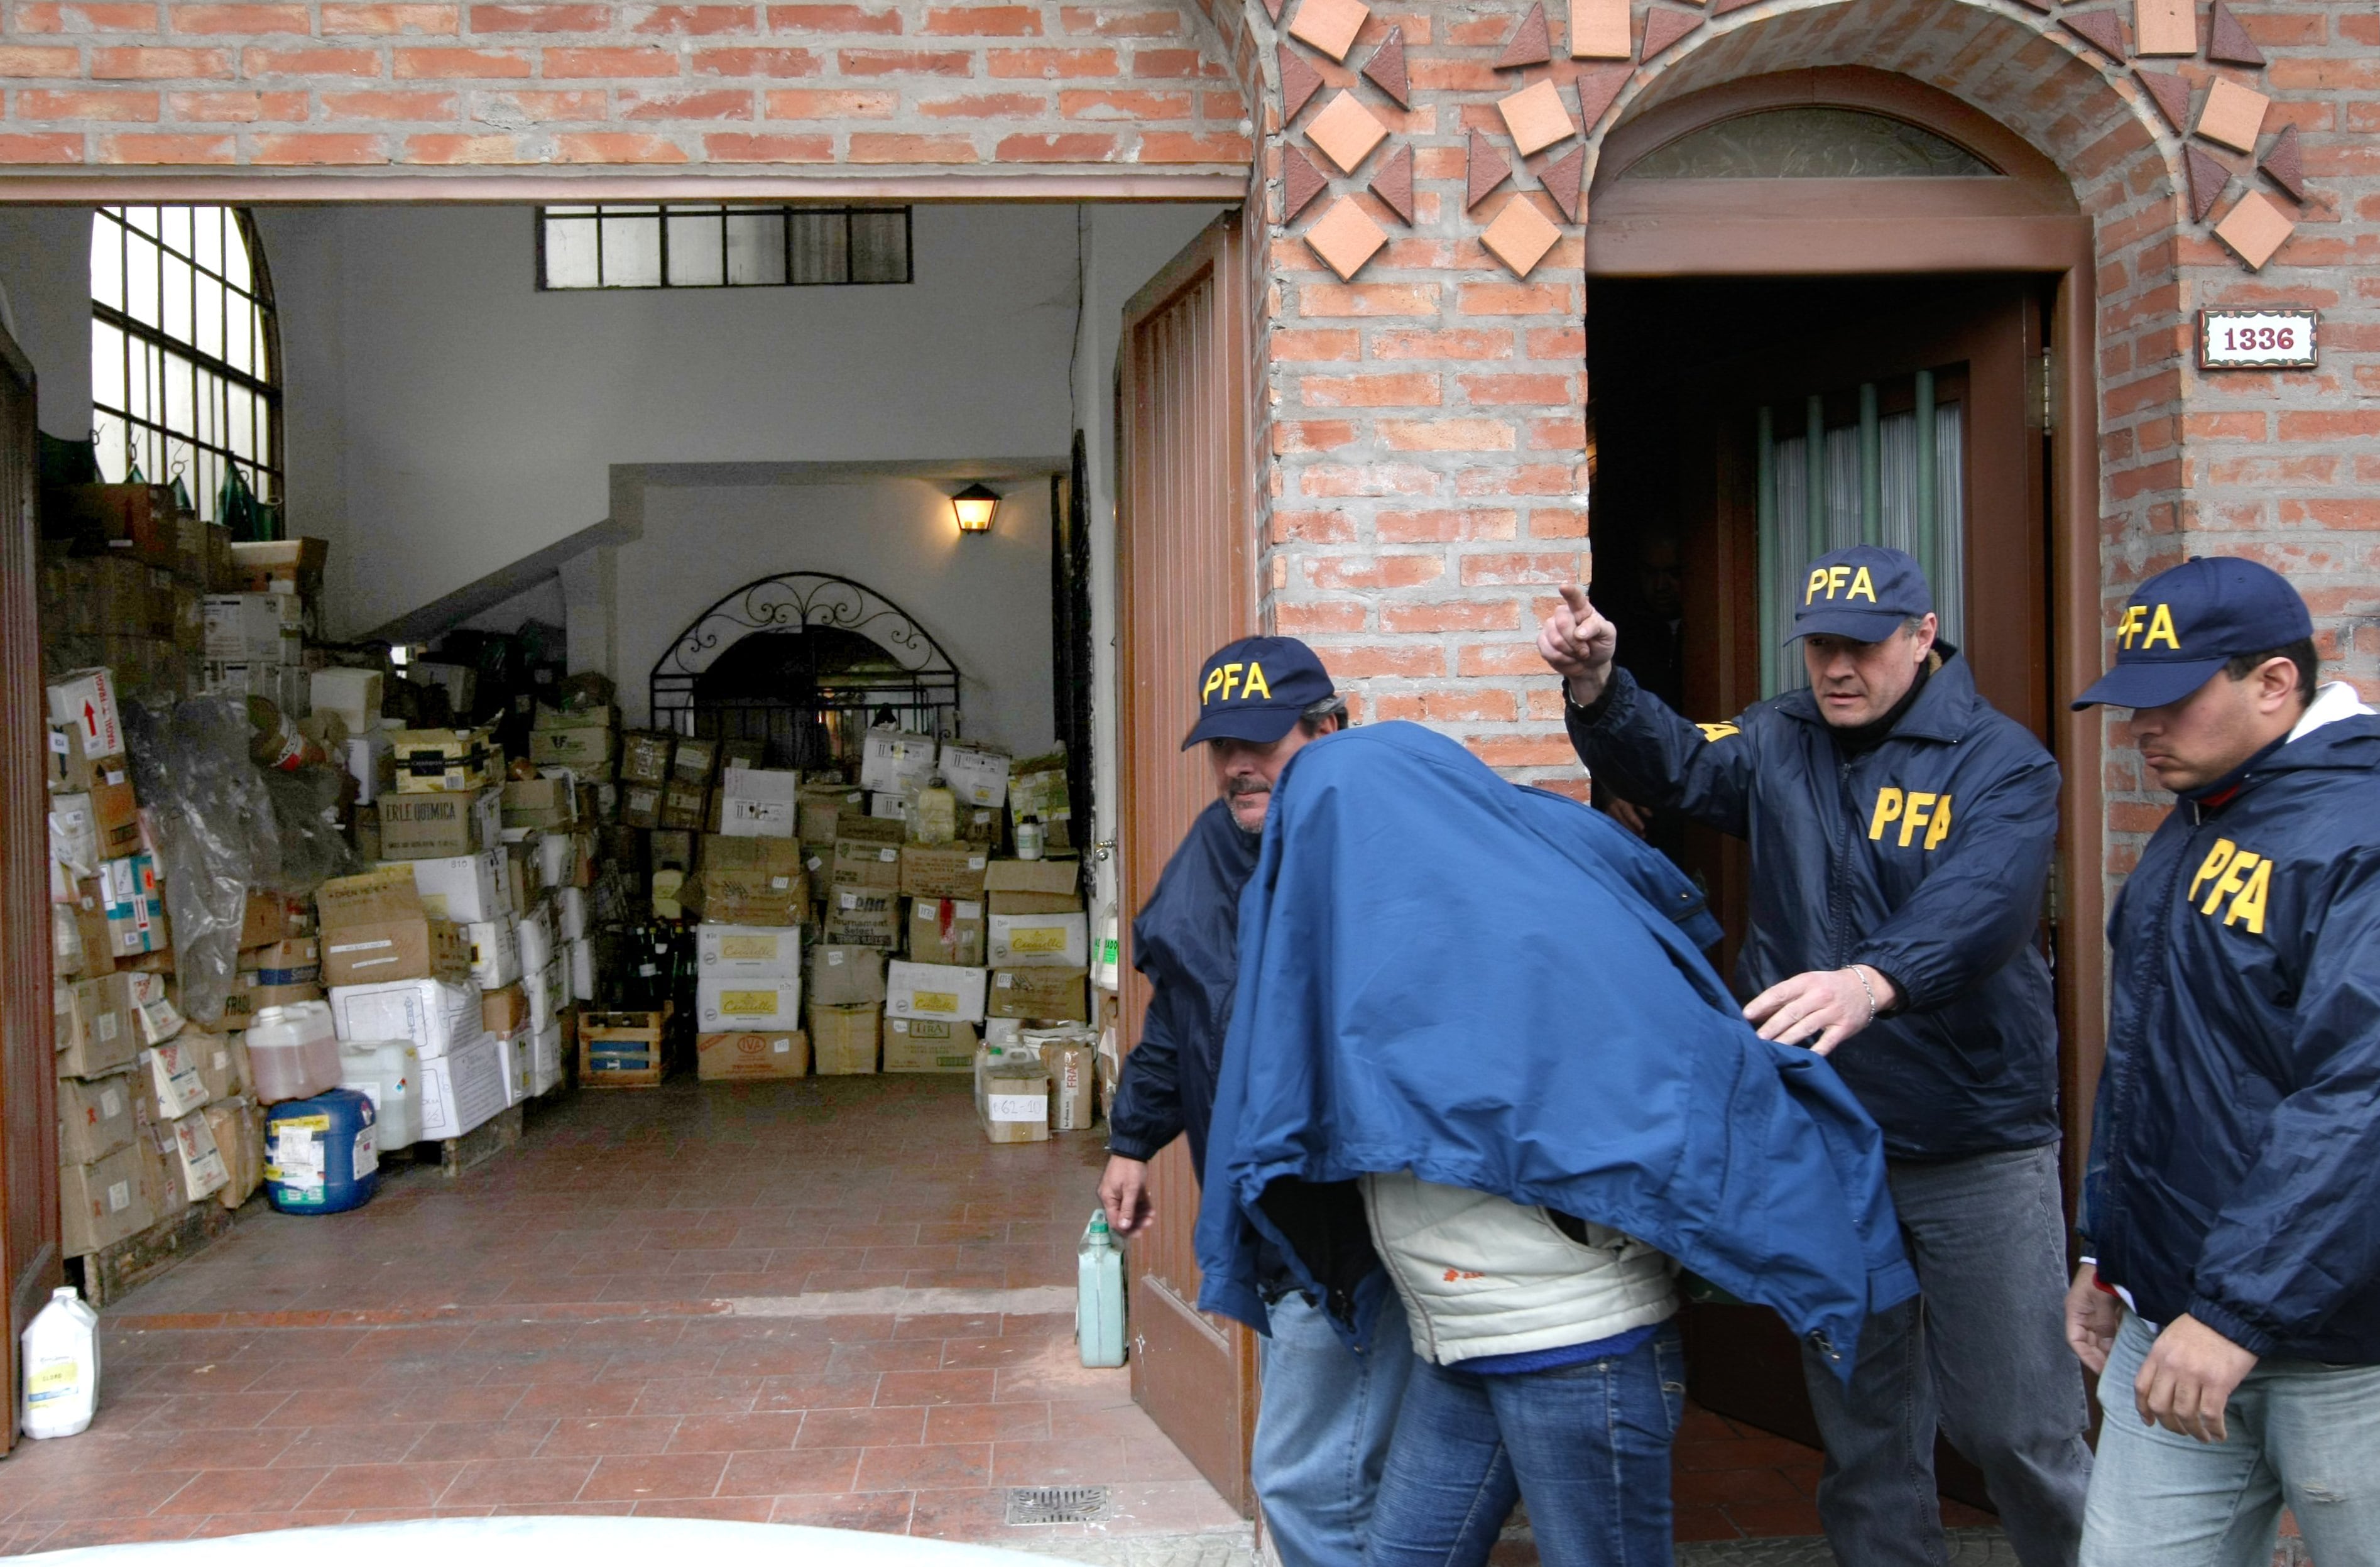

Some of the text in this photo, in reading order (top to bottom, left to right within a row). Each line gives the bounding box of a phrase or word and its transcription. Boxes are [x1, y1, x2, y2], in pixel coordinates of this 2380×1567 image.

[2224, 327, 2294, 350] 1336
[1805, 566, 1877, 606] PFA
[1203, 662, 1272, 705] PFA
[1868, 787, 1952, 850] PFA
[2188, 838, 2273, 934] PFA
